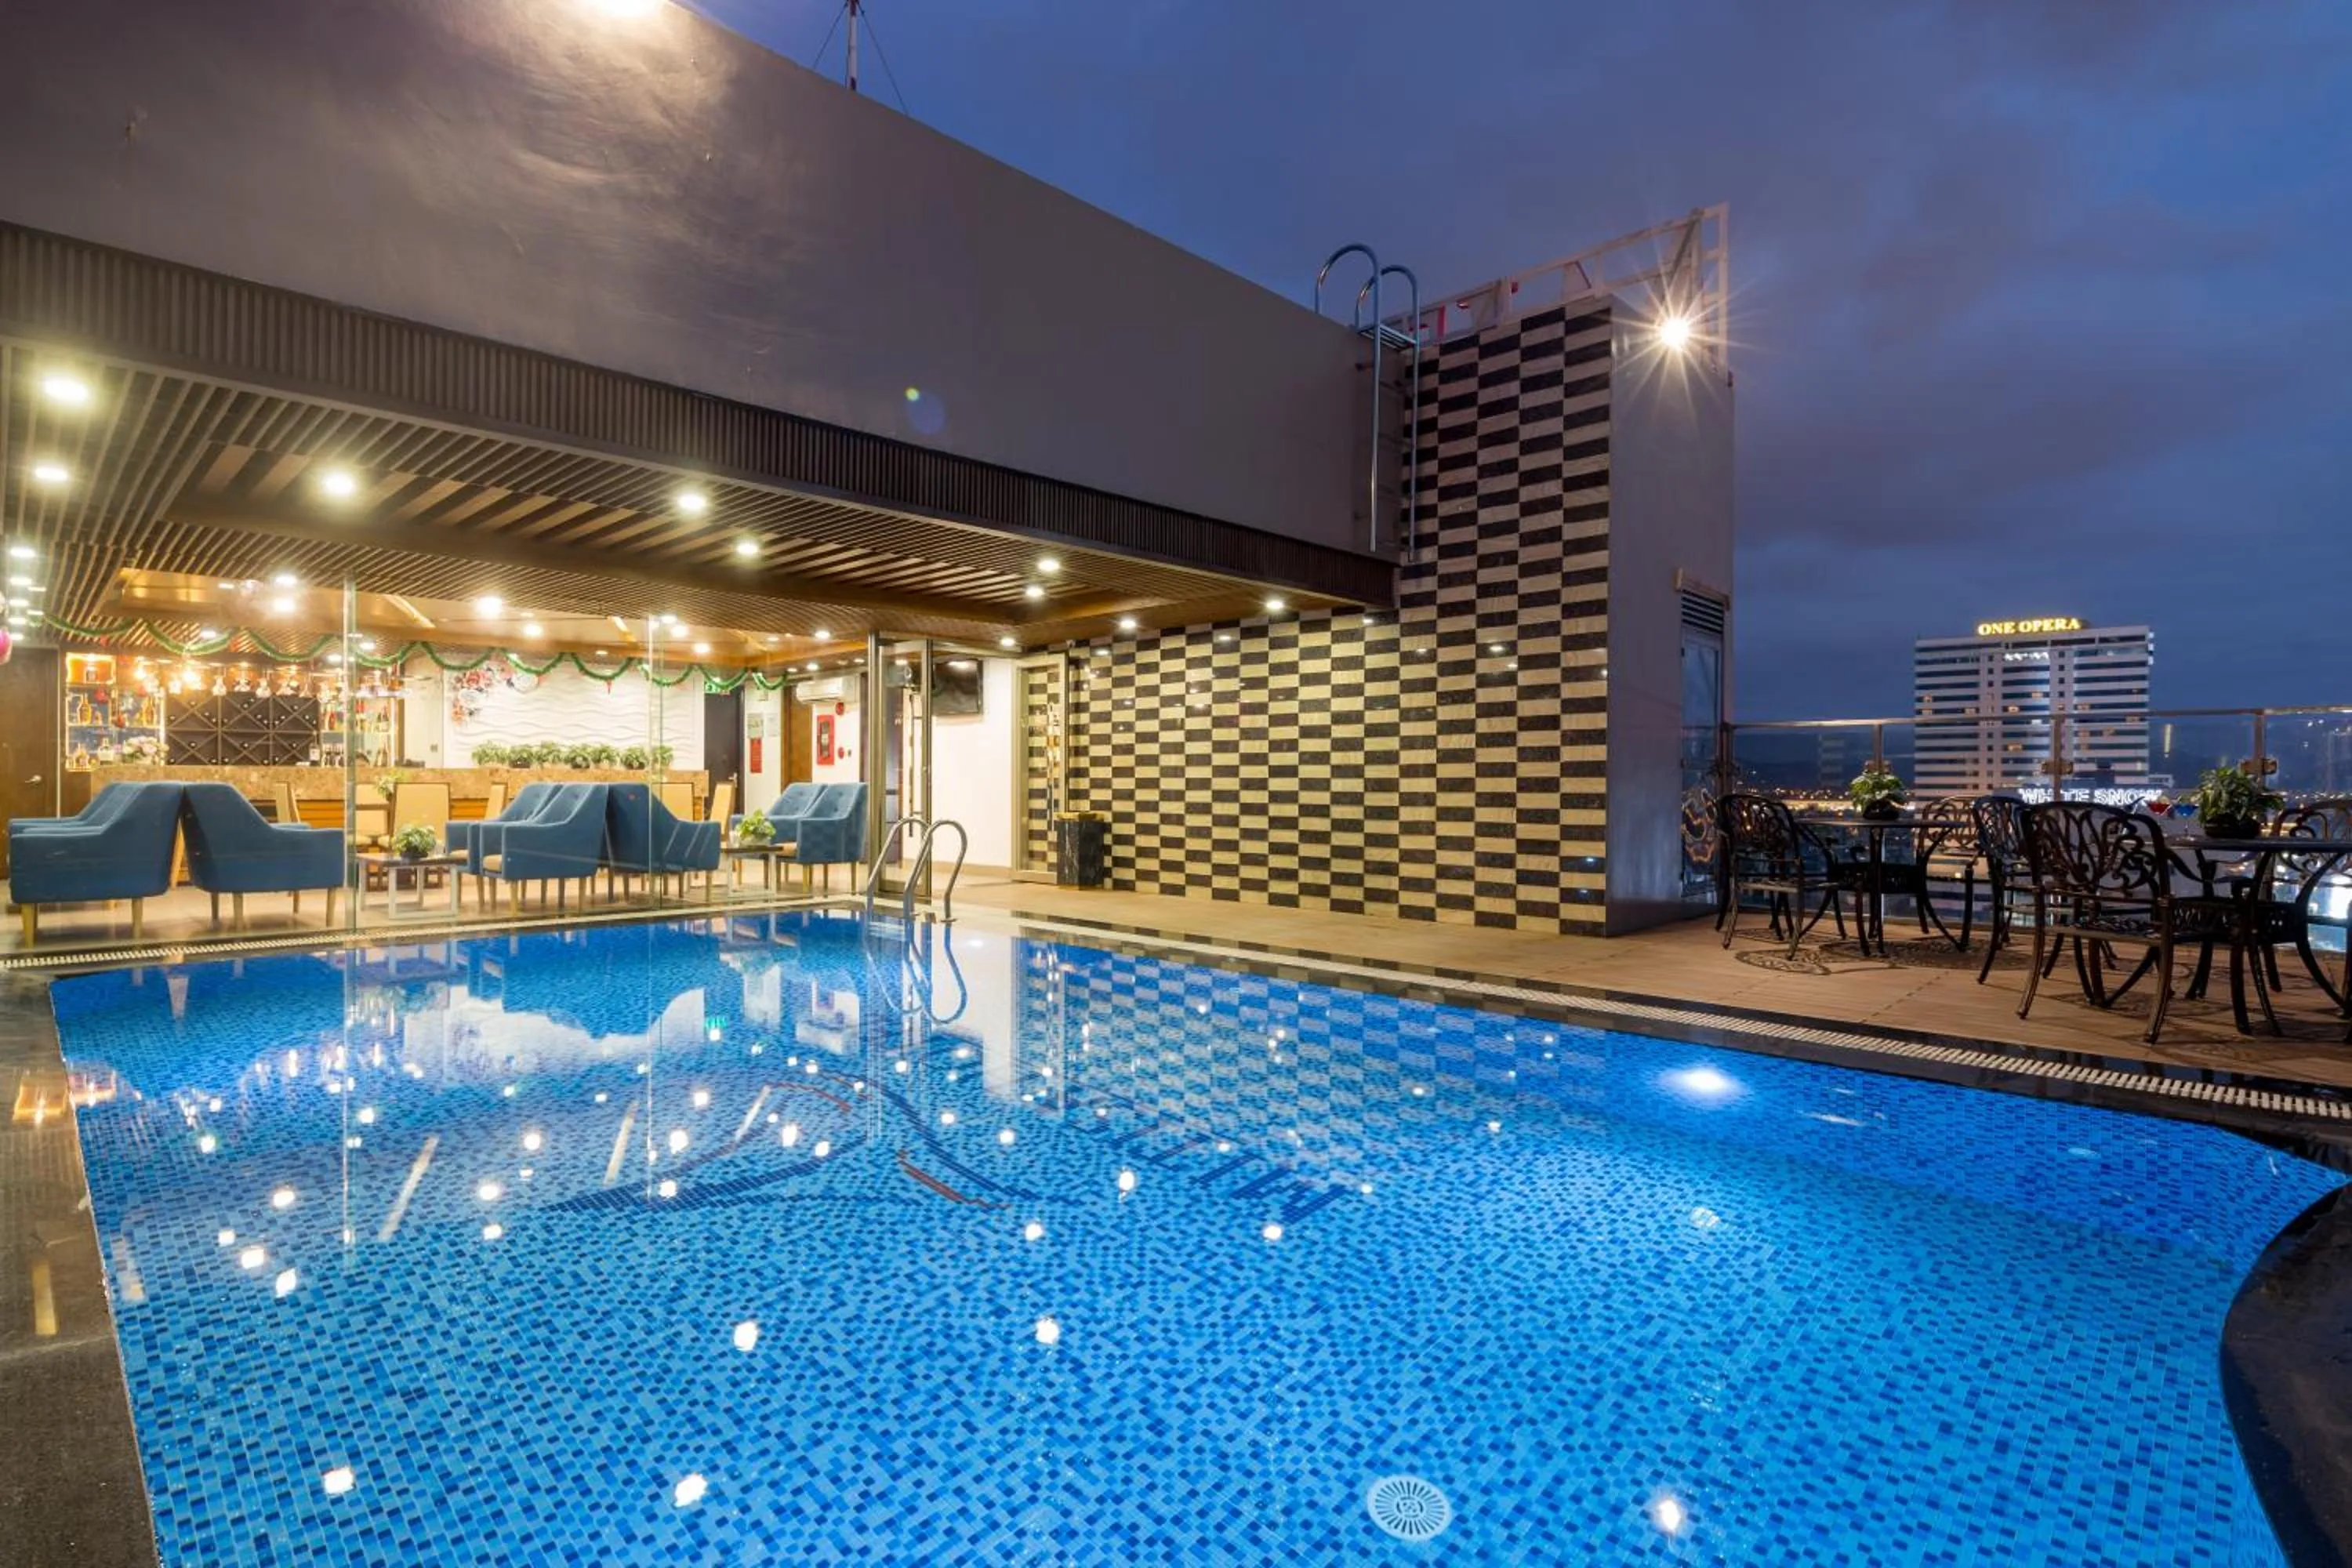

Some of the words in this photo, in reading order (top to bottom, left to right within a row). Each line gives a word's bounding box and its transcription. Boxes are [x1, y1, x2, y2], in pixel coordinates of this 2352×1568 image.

[1978, 622, 2016, 635] ONE
[2019, 617, 2080, 633] OPERA
[2018, 788, 2090, 804] WHTE
[2093, 788, 2162, 806] SNOW
